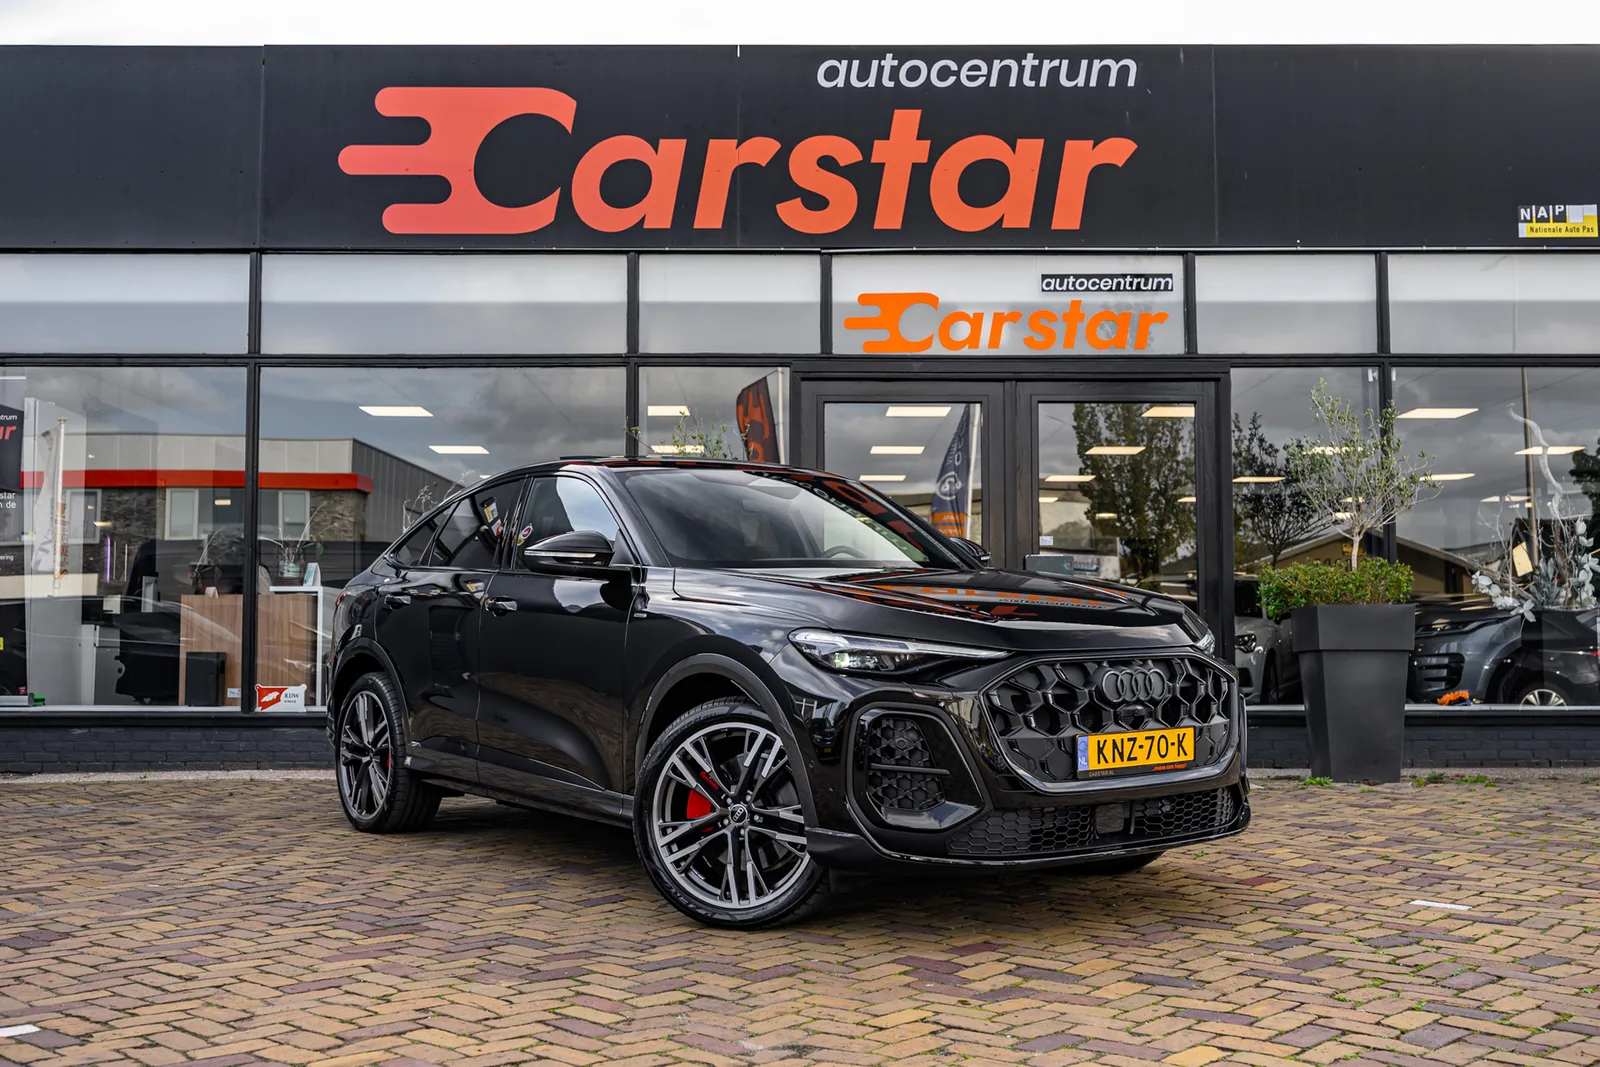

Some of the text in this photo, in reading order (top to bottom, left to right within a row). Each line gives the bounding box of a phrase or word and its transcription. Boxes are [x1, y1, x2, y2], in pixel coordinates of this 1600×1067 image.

[816, 52, 1138, 89] autocentrum
[337, 86, 1138, 235] Carstar
[1582, 225, 1595, 233] Pas
[1041, 274, 1173, 291] autocentrum
[843, 292, 1169, 353] Carstar
[5, 500, 17, 509] de
[1097, 732, 1188, 764] KNZ-70-K
[1078, 757, 1087, 766] NL
